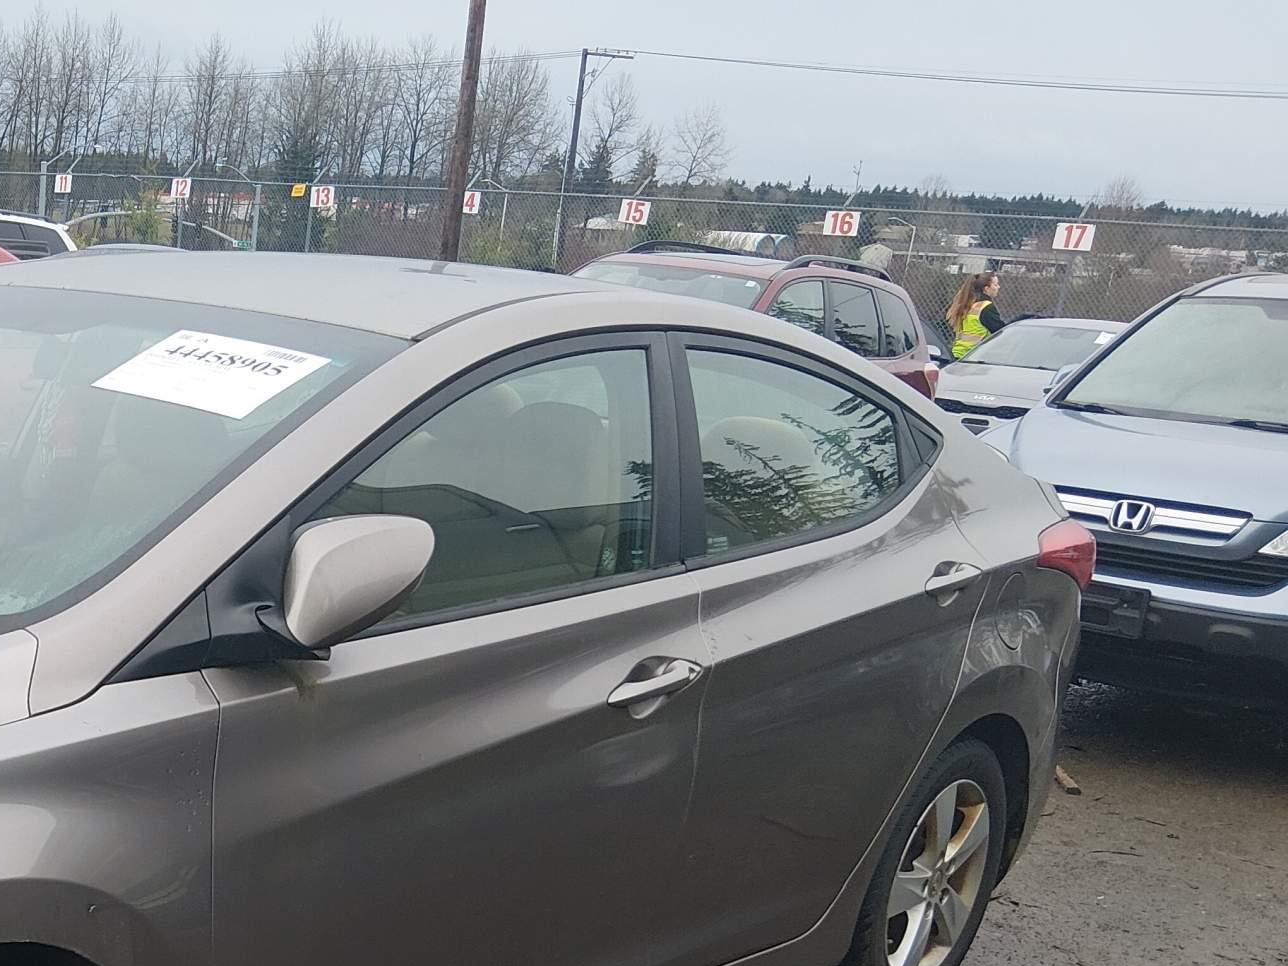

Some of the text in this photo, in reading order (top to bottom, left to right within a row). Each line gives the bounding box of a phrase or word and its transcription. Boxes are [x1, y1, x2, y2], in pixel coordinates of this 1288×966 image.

[59, 175, 68, 190] 11
[175, 179, 189, 195] 12
[315, 187, 330, 206] 13
[465, 193, 476, 212] 4
[625, 202, 646, 224] 15
[830, 212, 854, 235] 16
[1064, 224, 1088, 249] 17
[165, 345, 289, 376] 44458905
